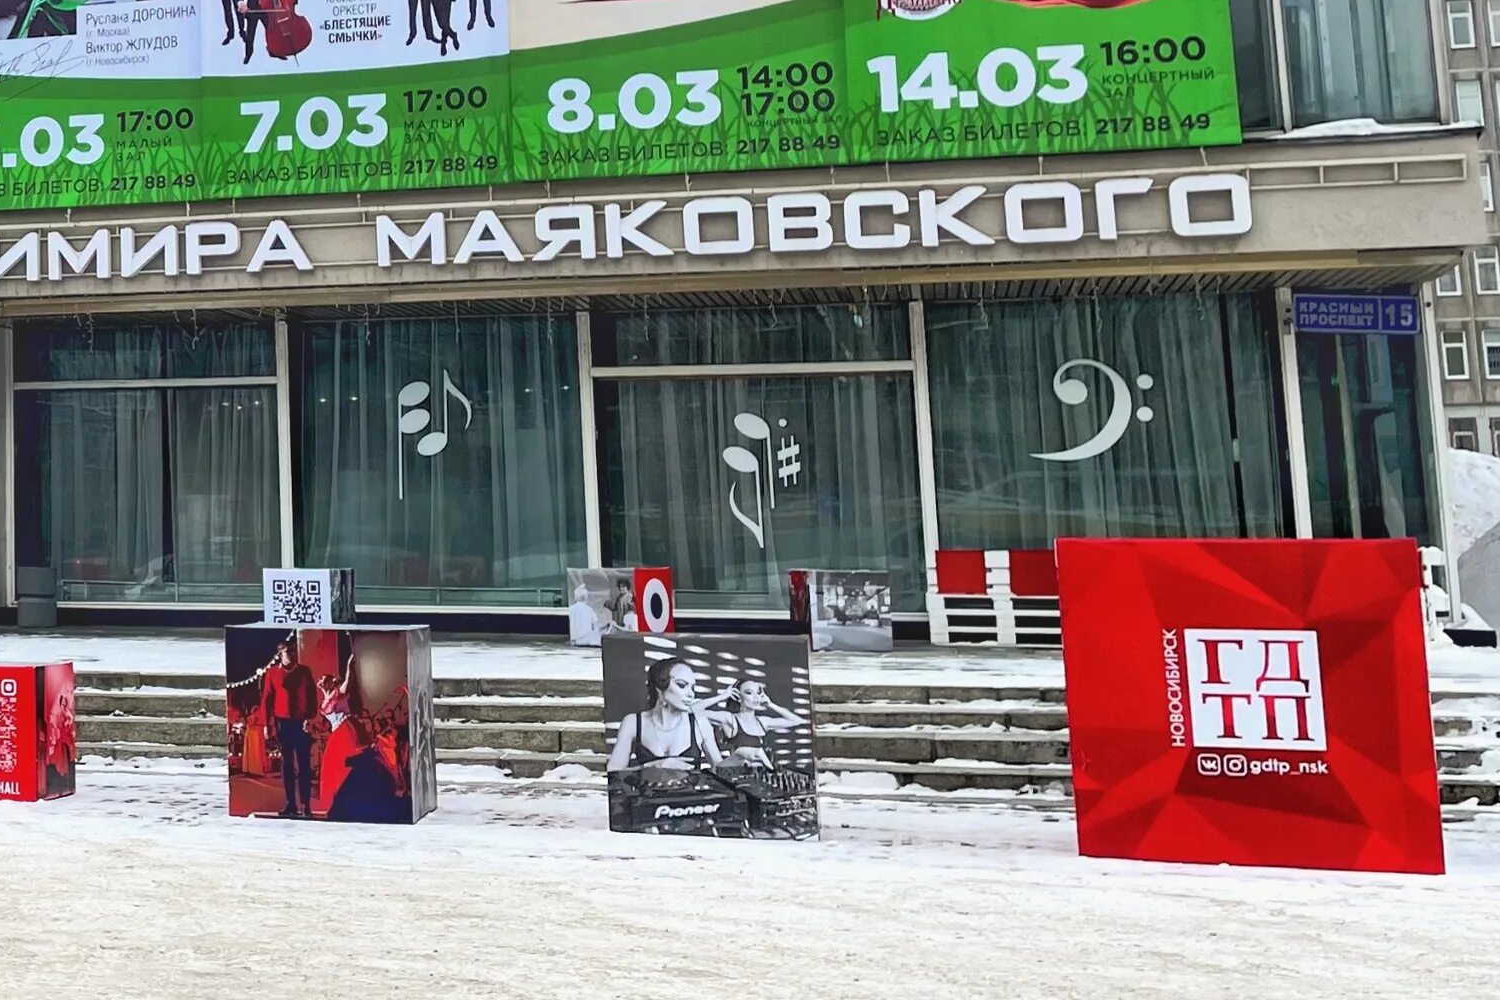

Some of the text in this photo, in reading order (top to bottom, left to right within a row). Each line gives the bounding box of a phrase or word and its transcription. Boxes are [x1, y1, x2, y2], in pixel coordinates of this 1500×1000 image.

[86, 5, 197, 26] Руслана ДОРОНИНА
[332, 3, 377, 17] ОРКЕСТР
[319, 16, 392, 31] «БЛЕСТЯЩИЕ
[86, 36, 178, 54] Виктор ЖЛУДОВ
[328, 30, 383, 43] СМЫЧКИ»
[1100, 36, 1206, 66] 16:00
[736, 61, 833, 90] 14:00
[866, 44, 1088, 113] 14.03
[1102, 67, 1214, 86] КОНЦЕРТНЫЙ
[403, 85, 488, 113] 17:00
[547, 69, 722, 133] 8.03
[741, 88, 835, 117] 17:00
[116, 107, 194, 133] 17:00
[240, 93, 388, 153] 7.03
[404, 116, 465, 130] МАЛЫЙ
[877, 113, 1211, 146] ЗАКАЗ БИЛЕТОВ: 217 88 49
[116, 137, 172, 149] МАЛЫЙ
[538, 133, 841, 166] ЗАКАЗ БИЛЕТОВ: 217 88 49
[375, 172, 1253, 268] МАЯКОВСКОГО
[1300, 302, 1374, 314] КРАСНЫЙ
[1385, 304, 1413, 326] 15
[1300, 314, 1374, 326] ПРОСПЕКТ
[1161, 628, 1186, 748] НОВОСИБИРСК
[1250, 759, 1328, 775] gdtp_nsk
[654, 803, 720, 820] Pioneer
